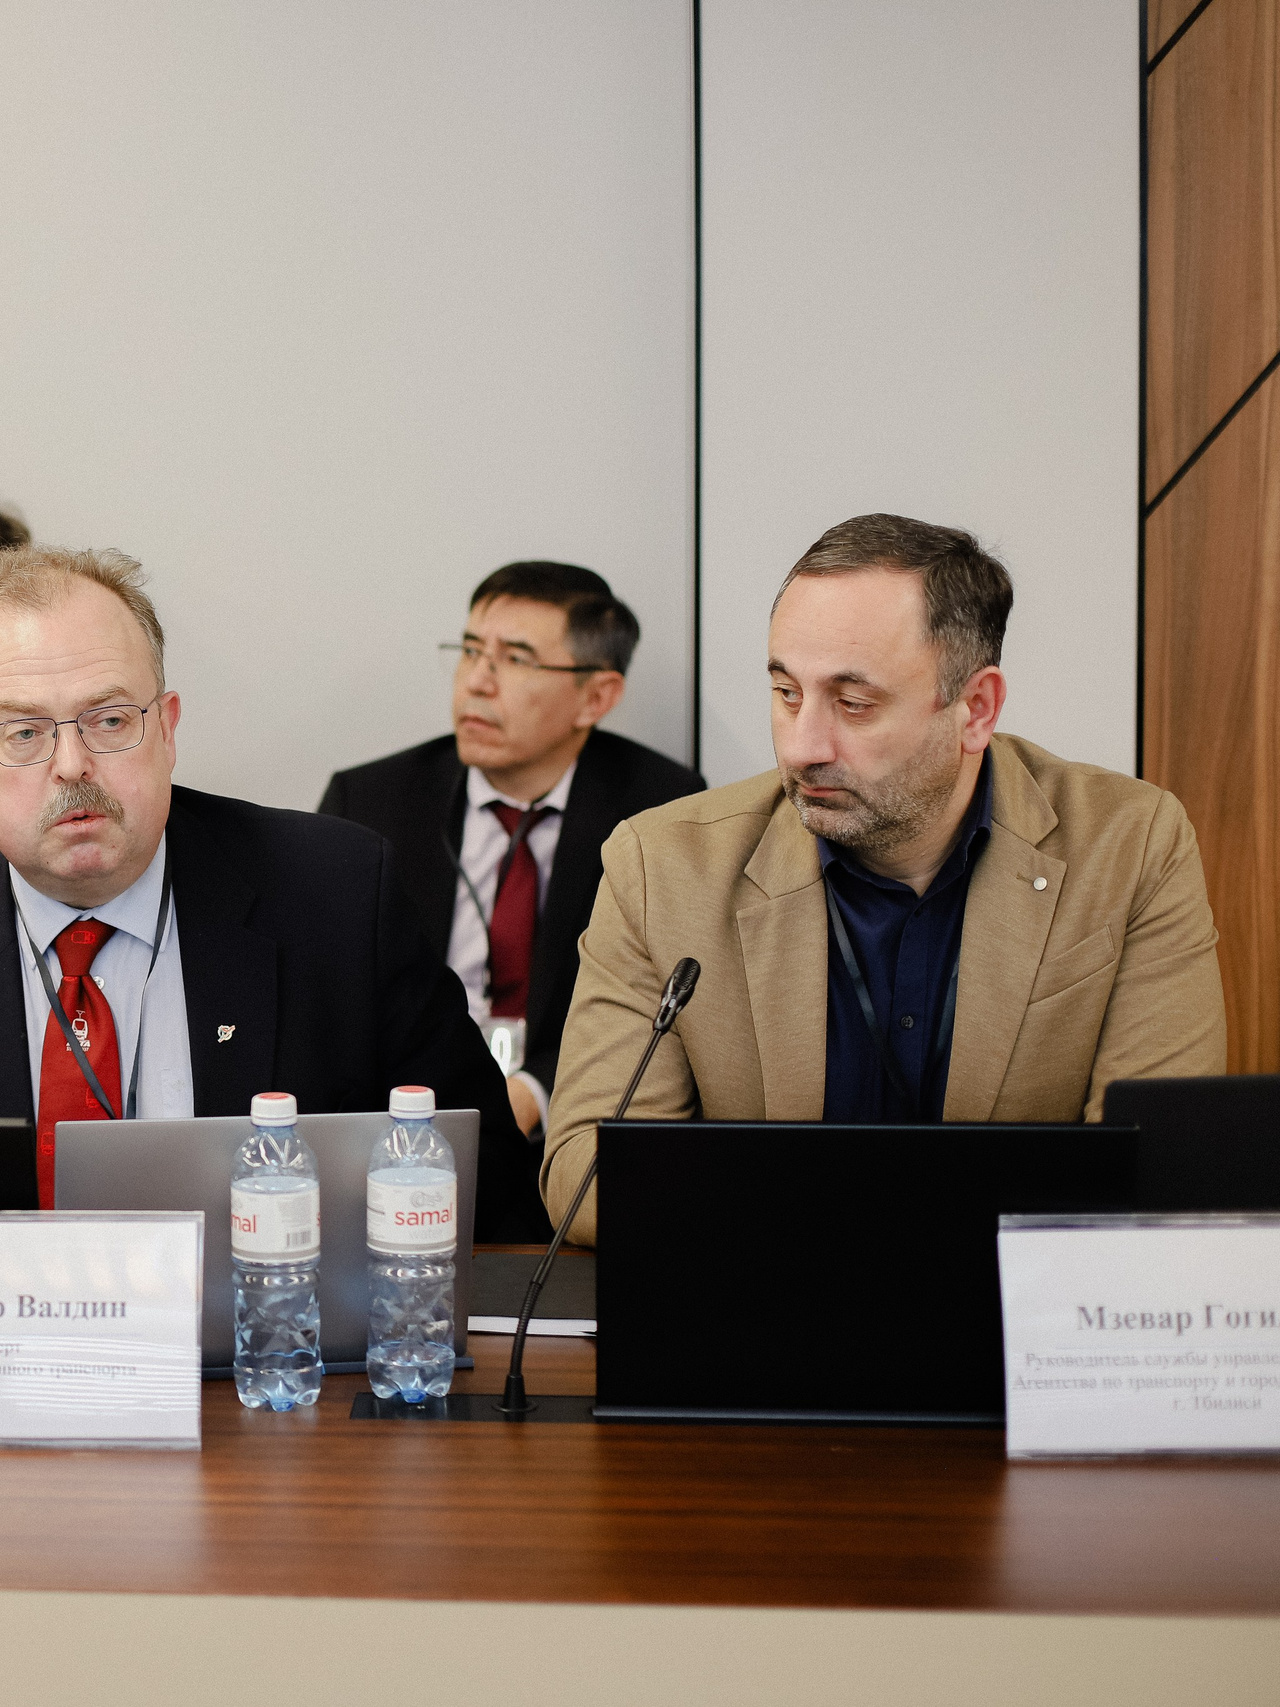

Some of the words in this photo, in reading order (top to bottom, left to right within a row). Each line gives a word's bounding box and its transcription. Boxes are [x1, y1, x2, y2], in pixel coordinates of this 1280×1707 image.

[231, 1212, 257, 1234] mal
[394, 1202, 453, 1226] samal
[17, 1294, 128, 1320] Валдин
[1077, 1304, 1193, 1336] Мзевар
[1204, 1304, 1280, 1330] Гоги
[1025, 1352, 1140, 1371] Руководитель
[1144, 1351, 1209, 1369] службы
[1212, 1353, 1280, 1369] управле
[1012, 1375, 1098, 1390] Агентства
[1127, 1376, 1219, 1393] транспорту
[1240, 1376, 1280, 1392] горо
